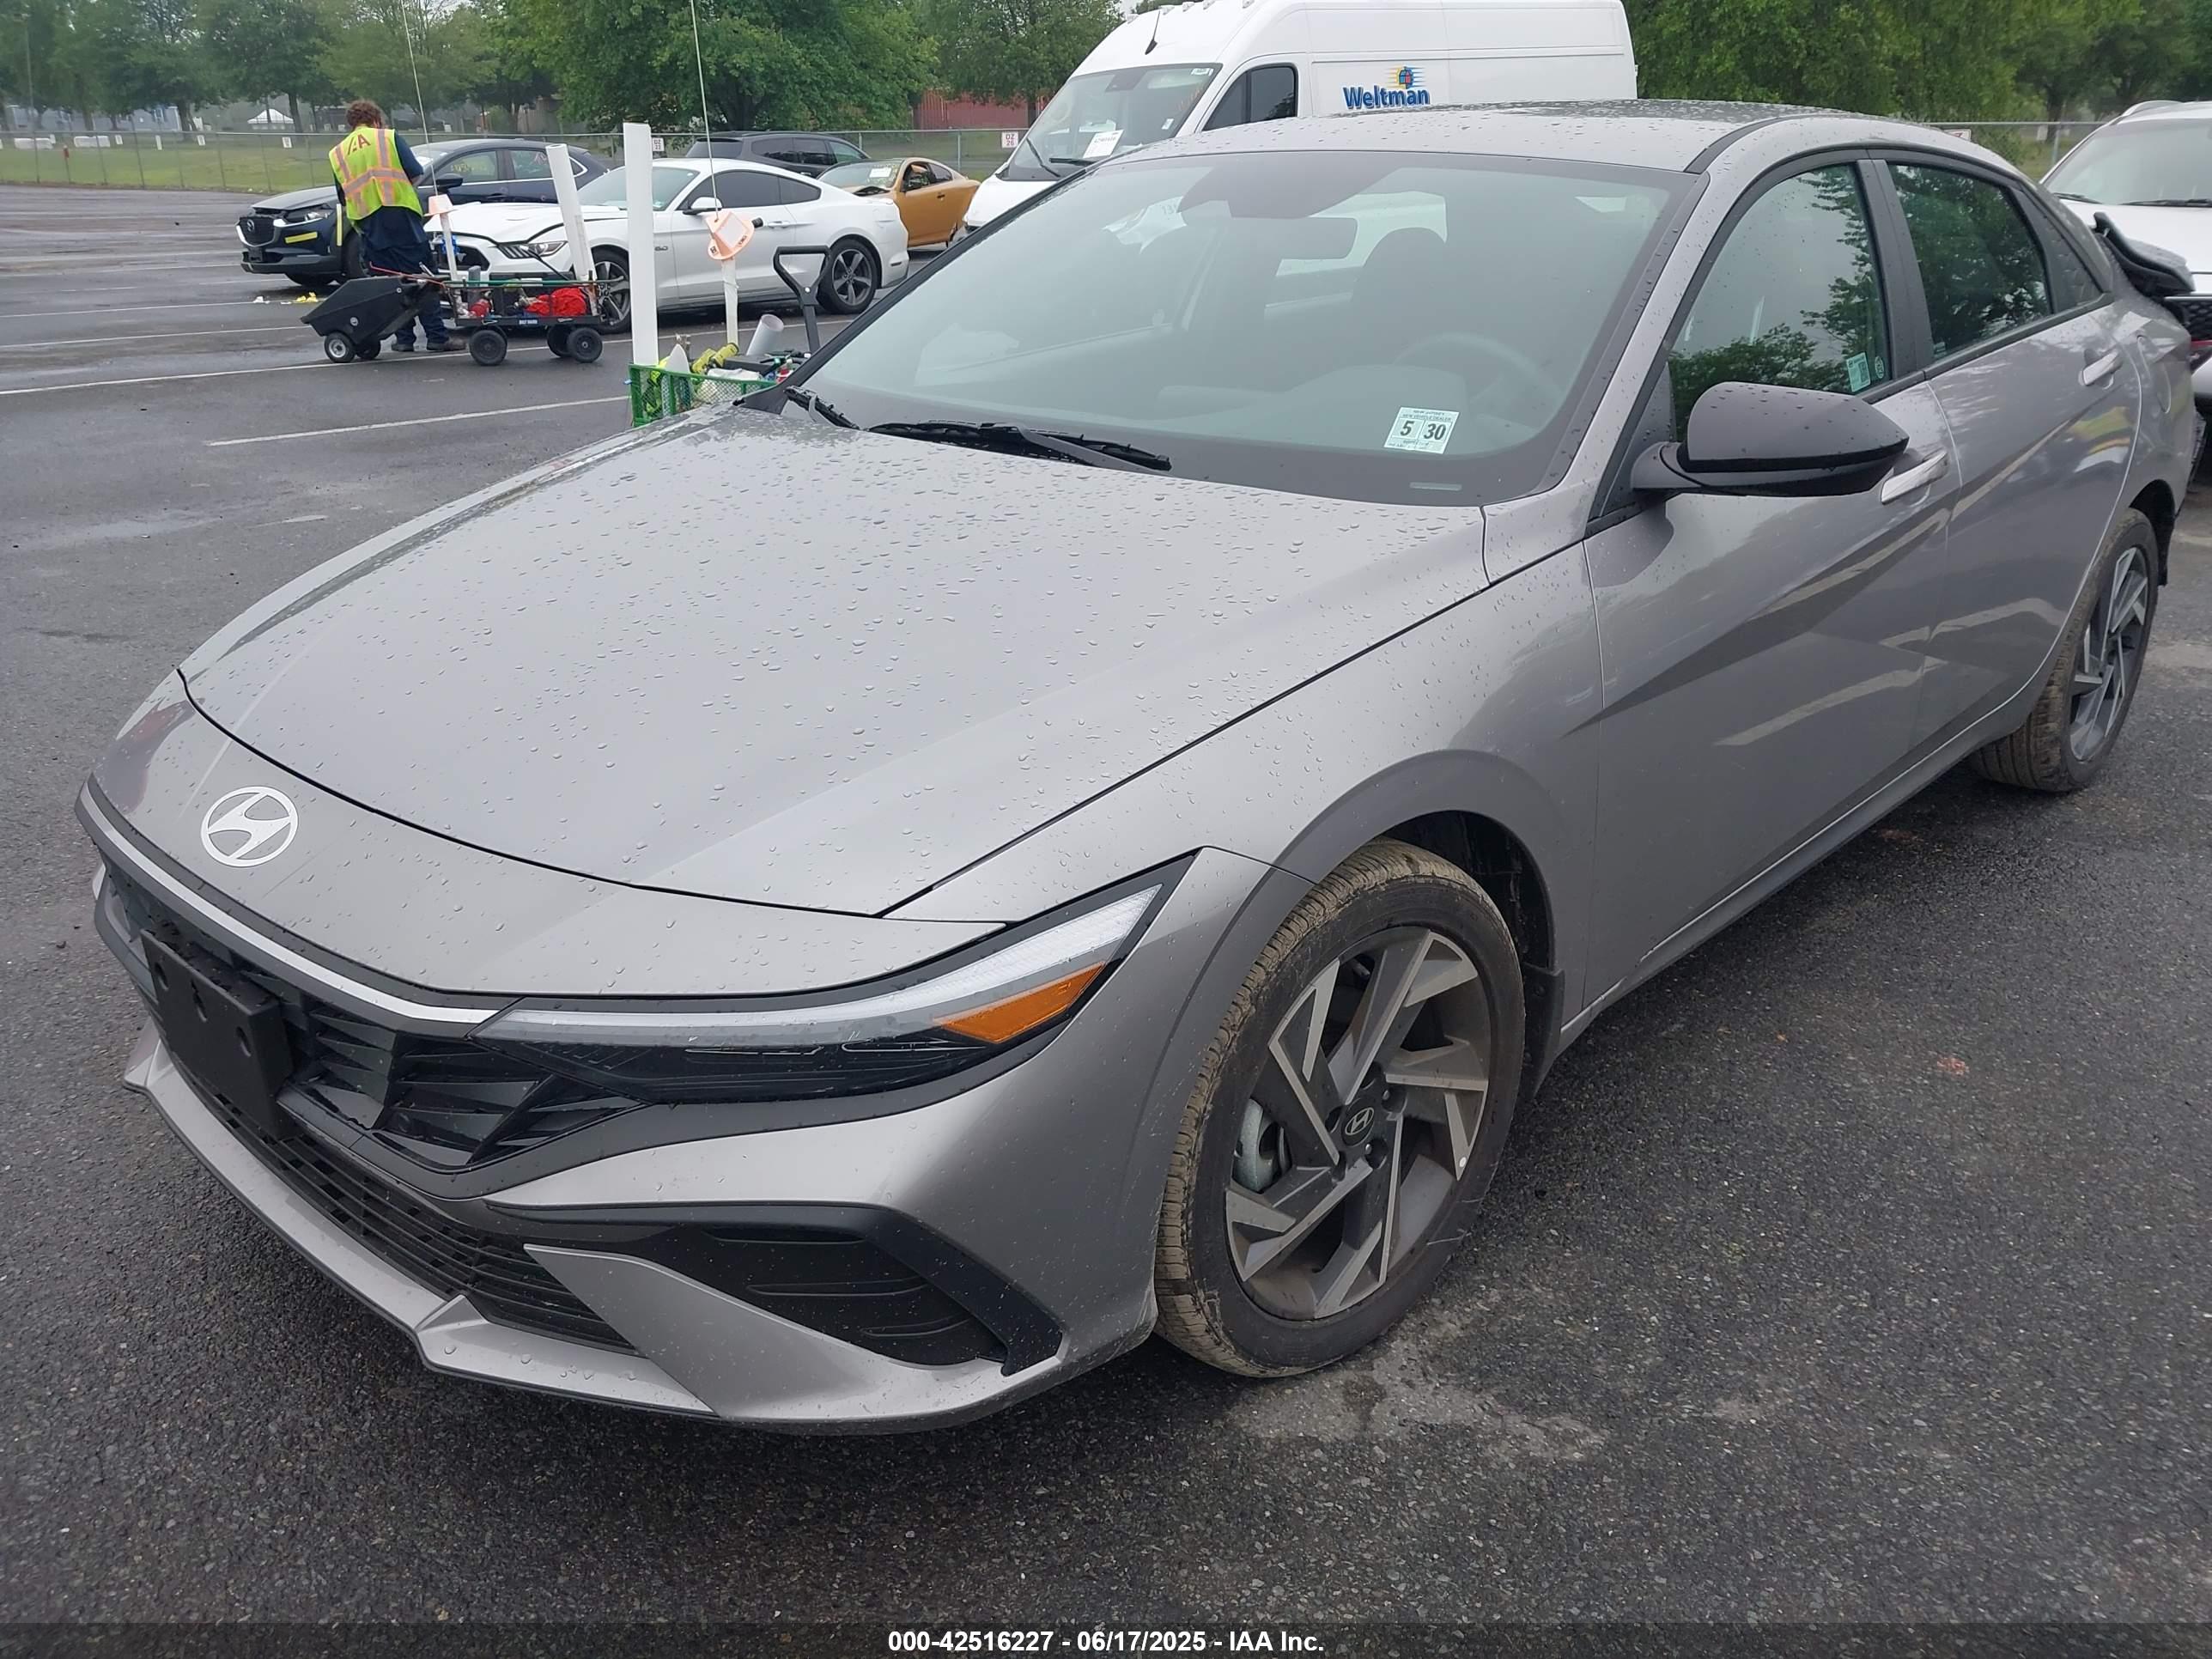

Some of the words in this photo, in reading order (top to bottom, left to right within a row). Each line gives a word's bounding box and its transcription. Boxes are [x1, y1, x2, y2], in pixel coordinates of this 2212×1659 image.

[1342, 85, 1431, 109] Weltman
[1400, 420, 1415, 435] 5
[1424, 423, 1446, 440] 30
